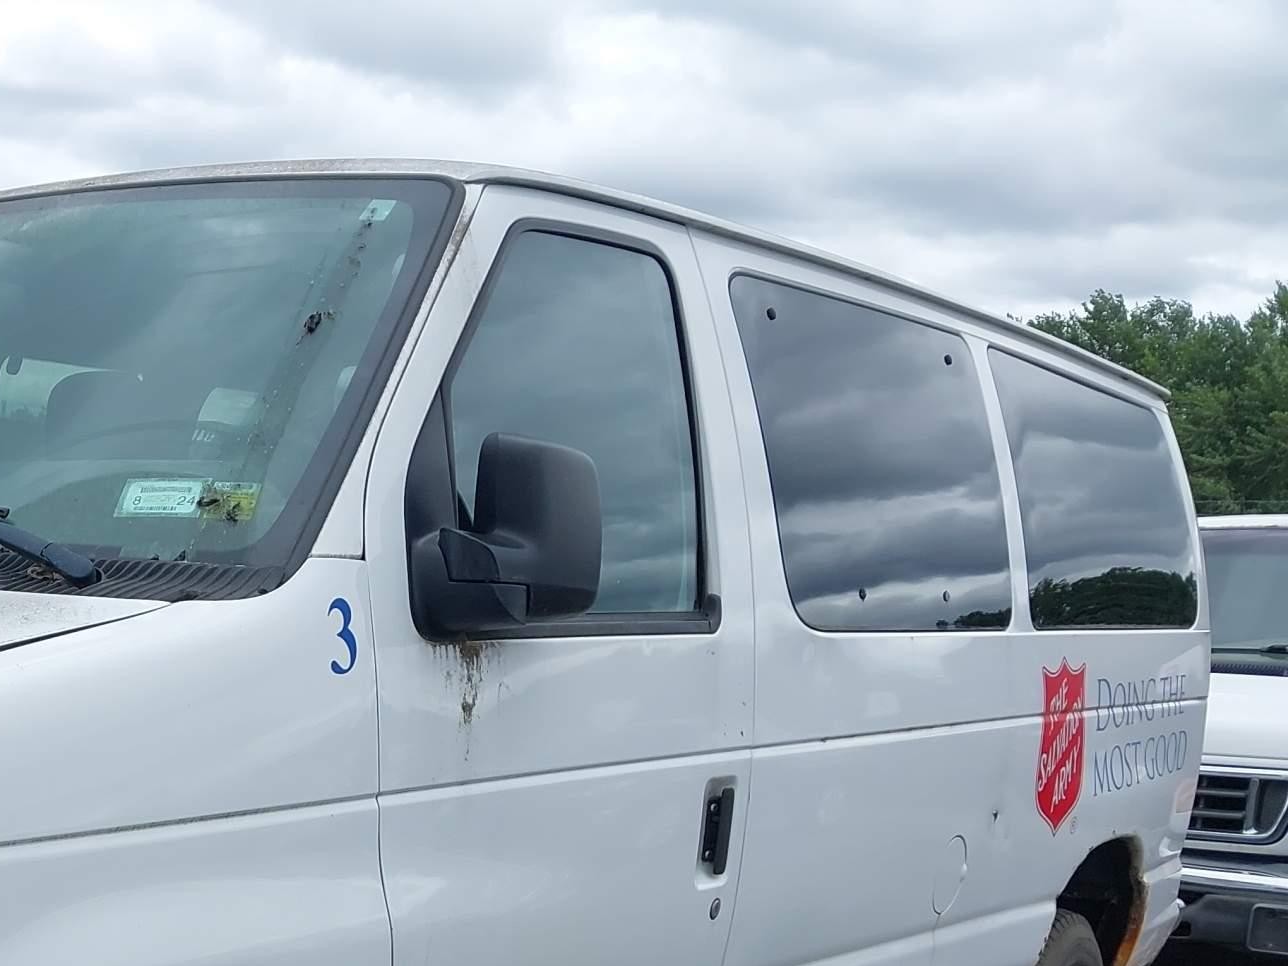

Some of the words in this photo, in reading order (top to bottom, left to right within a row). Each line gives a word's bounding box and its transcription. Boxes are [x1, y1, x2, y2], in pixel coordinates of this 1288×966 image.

[132, 495, 142, 505] 8
[176, 495, 195, 506] 24
[327, 597, 357, 675] 3
[1049, 678, 1070, 736] THE
[1096, 678, 1156, 732] DOING
[1160, 674, 1187, 719] THE
[1038, 687, 1085, 792] SALVATION
[1093, 740, 1142, 797] MOST
[1144, 730, 1188, 781] GOOD
[1050, 735, 1081, 814] ARMY
